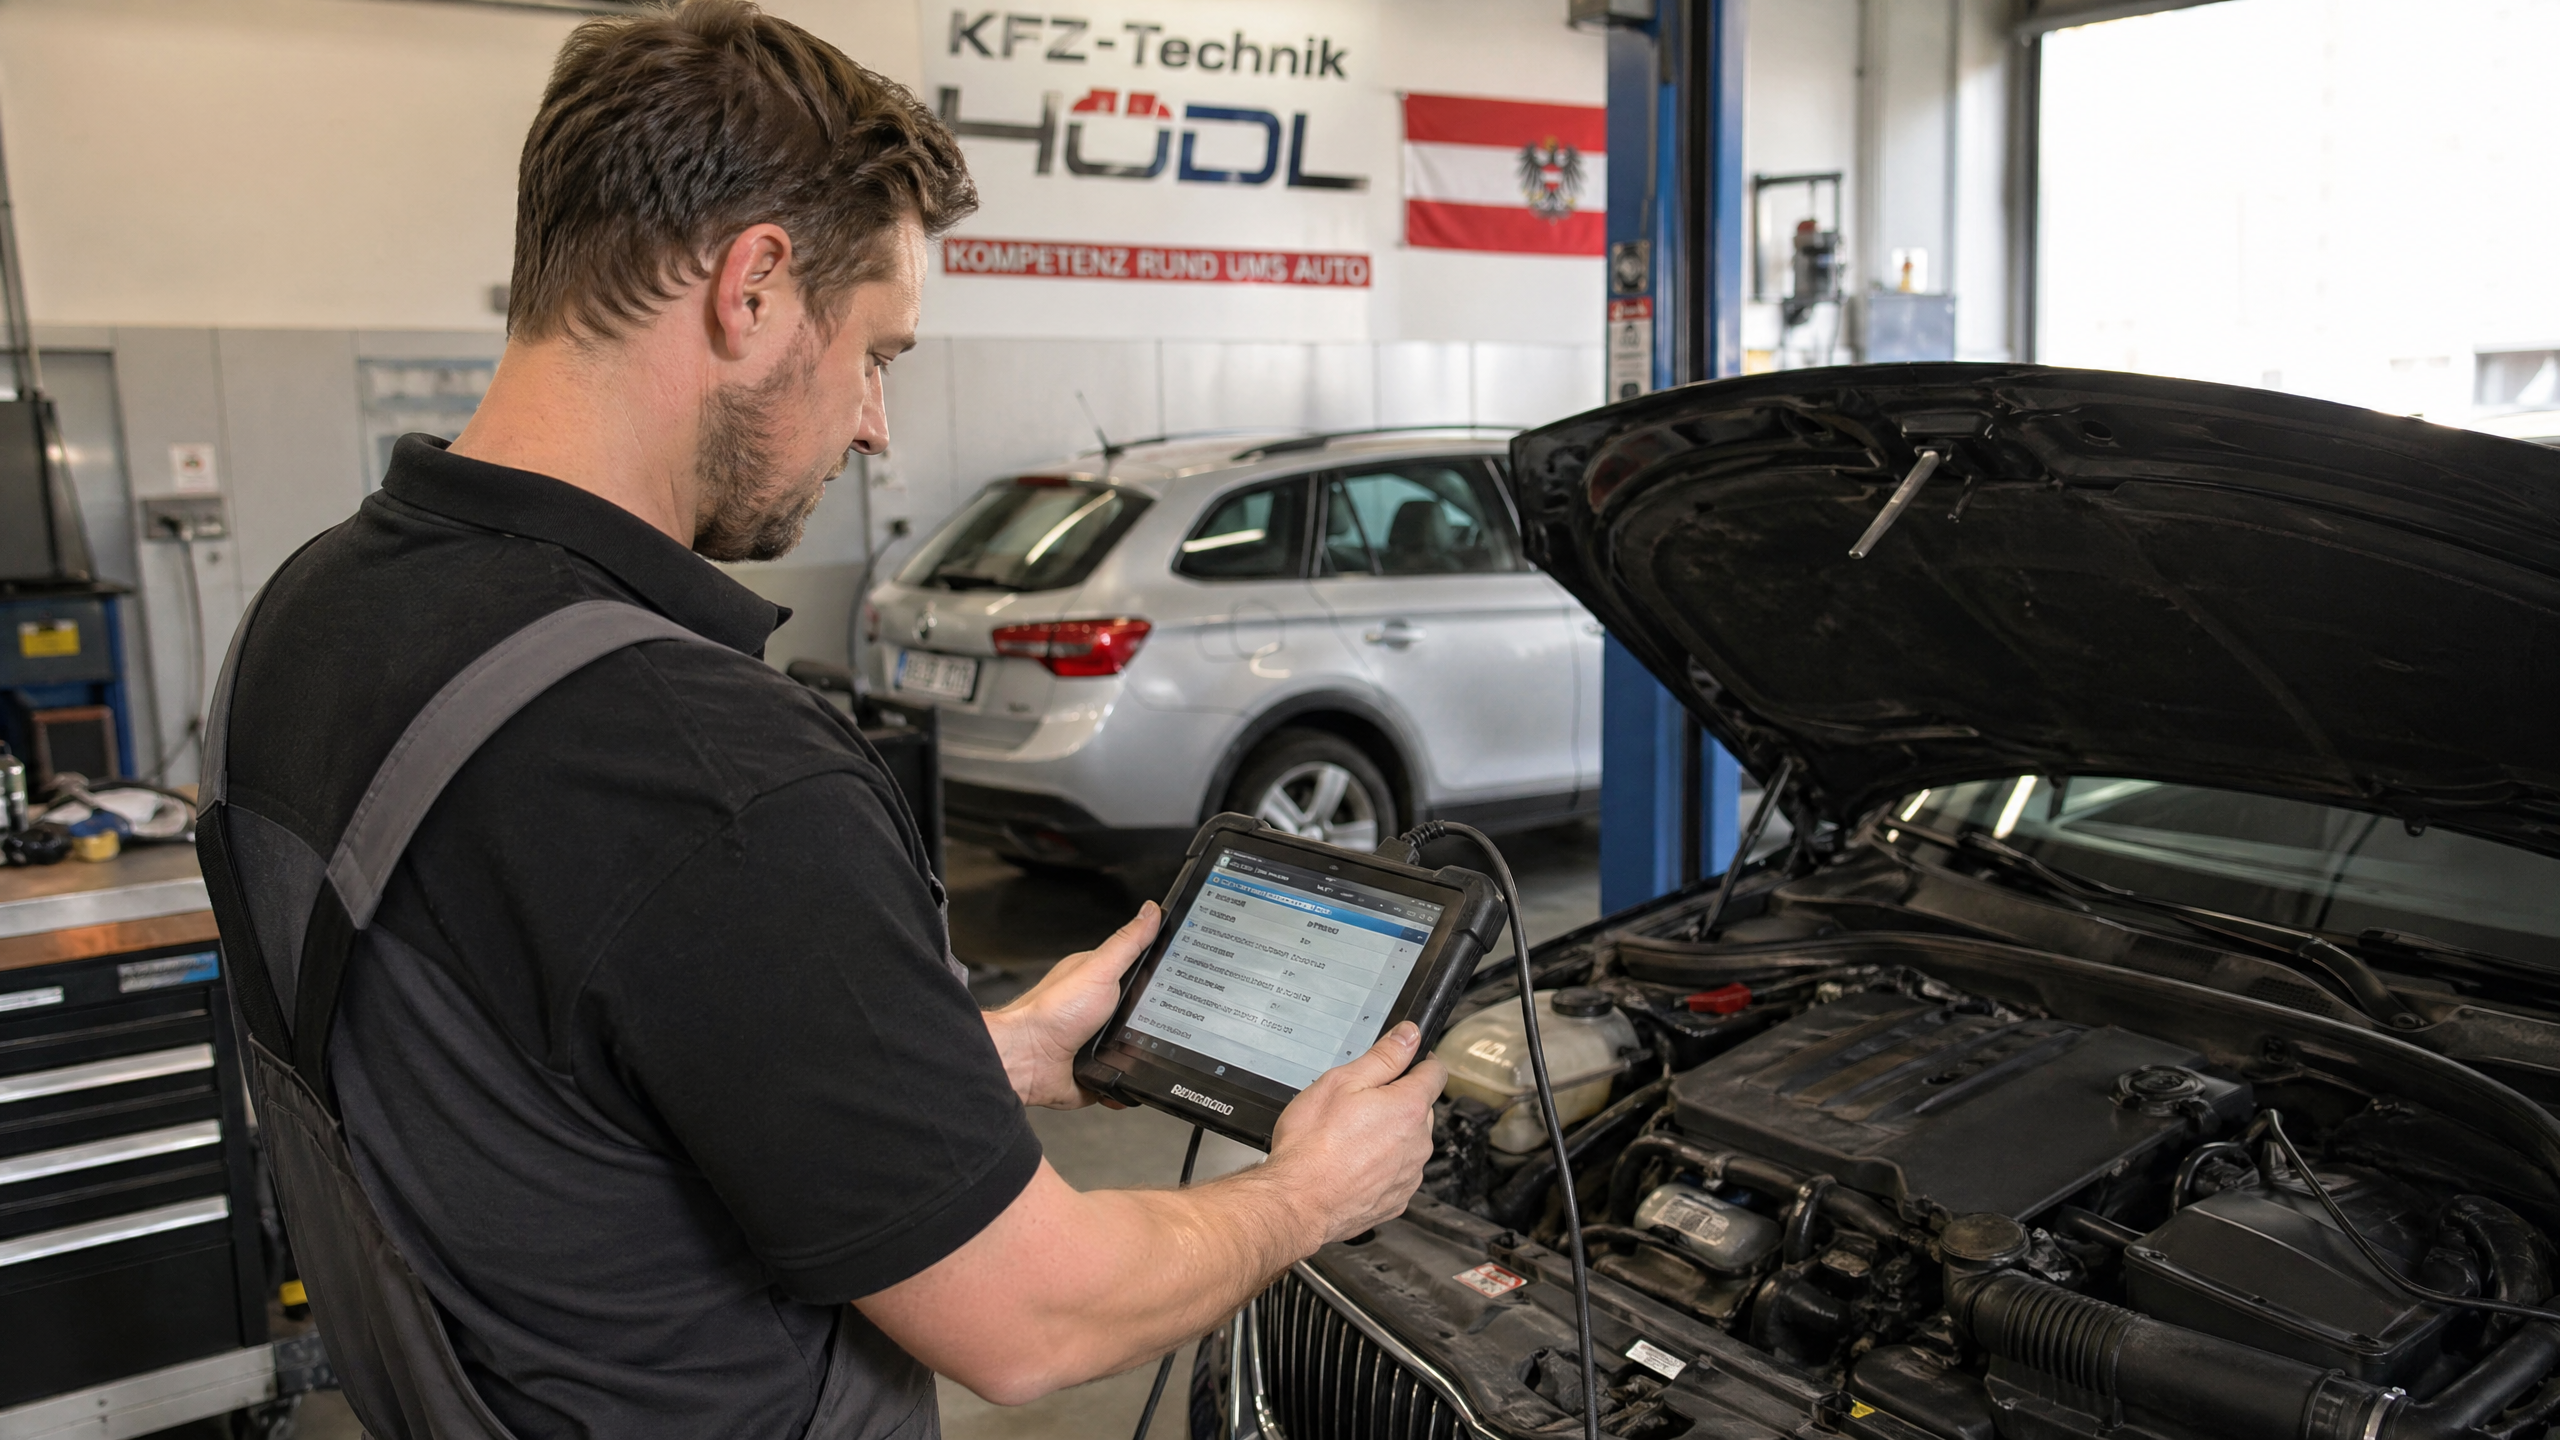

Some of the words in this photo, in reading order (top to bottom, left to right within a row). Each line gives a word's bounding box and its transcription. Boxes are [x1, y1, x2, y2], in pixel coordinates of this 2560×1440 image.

[949, 11, 1347, 79] KFZ-Technik
[947, 241, 1130, 277] KOMPETENZ
[1136, 249, 1219, 281] RUND
[1225, 253, 1288, 284] UMS
[1293, 256, 1368, 286] AUTO
